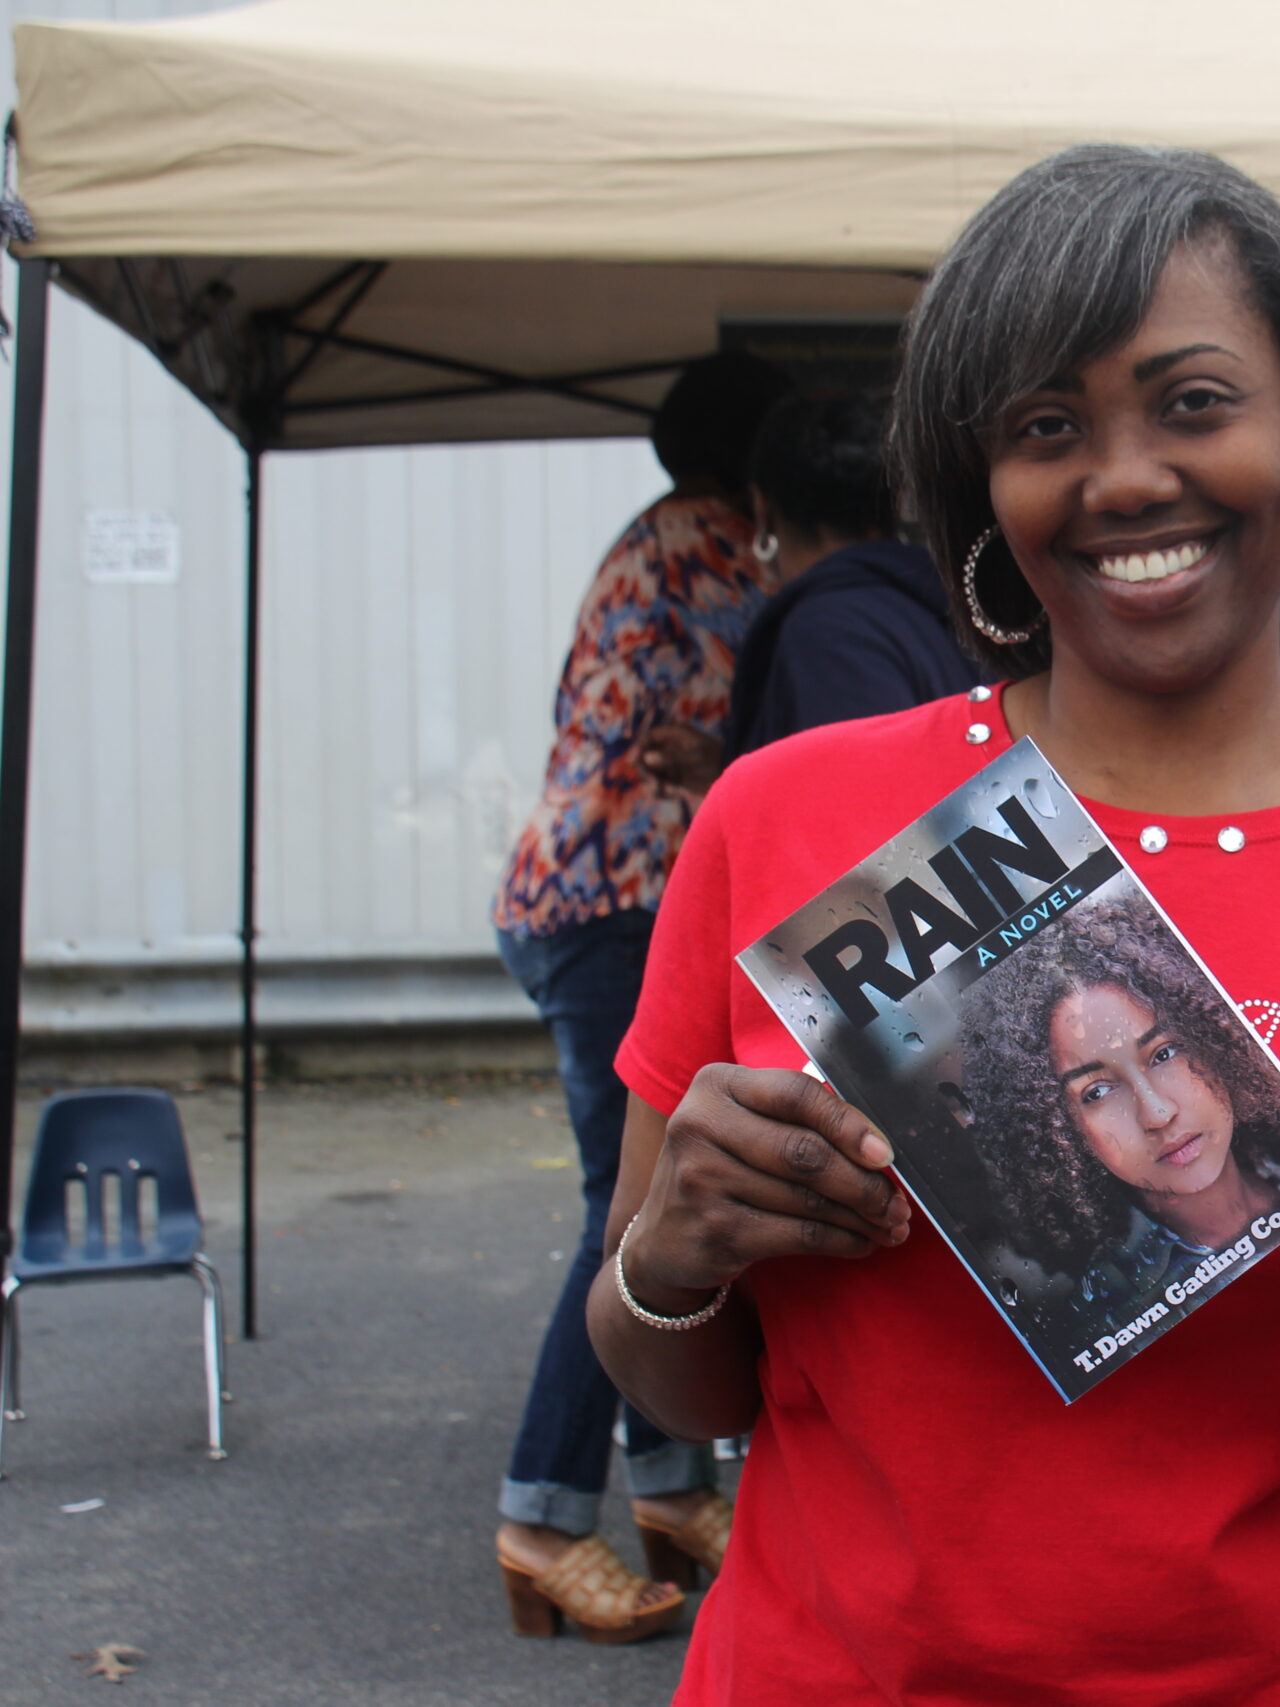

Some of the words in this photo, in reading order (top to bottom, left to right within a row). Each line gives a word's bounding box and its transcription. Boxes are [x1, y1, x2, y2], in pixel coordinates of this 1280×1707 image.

[802, 795, 1071, 1030] RAIN
[975, 946, 997, 968] A
[998, 884, 1083, 948] NOVEL
[1164, 1234, 1256, 1306] Gatling
